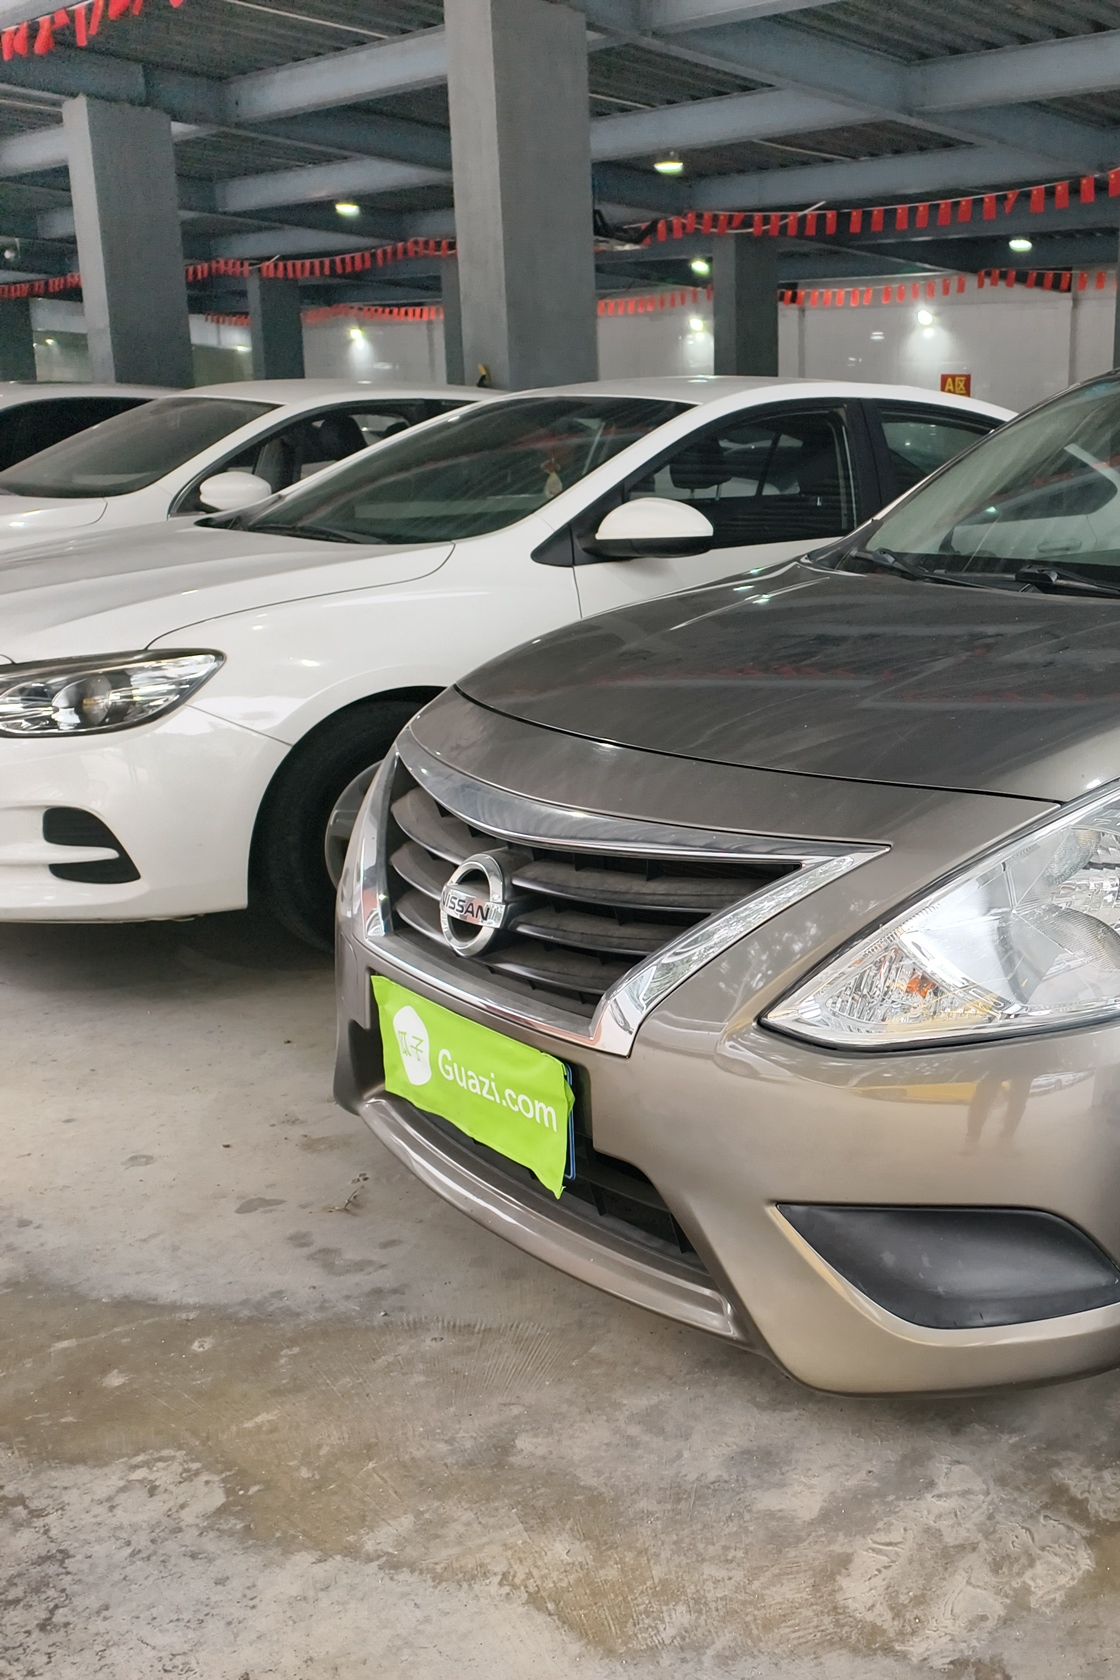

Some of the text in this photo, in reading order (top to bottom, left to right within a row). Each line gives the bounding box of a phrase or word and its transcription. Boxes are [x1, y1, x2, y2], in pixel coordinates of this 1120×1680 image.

[944, 376, 967, 394] A区
[442, 890, 490, 921] NISSAN
[438, 1049, 557, 1132] Guazi.com
